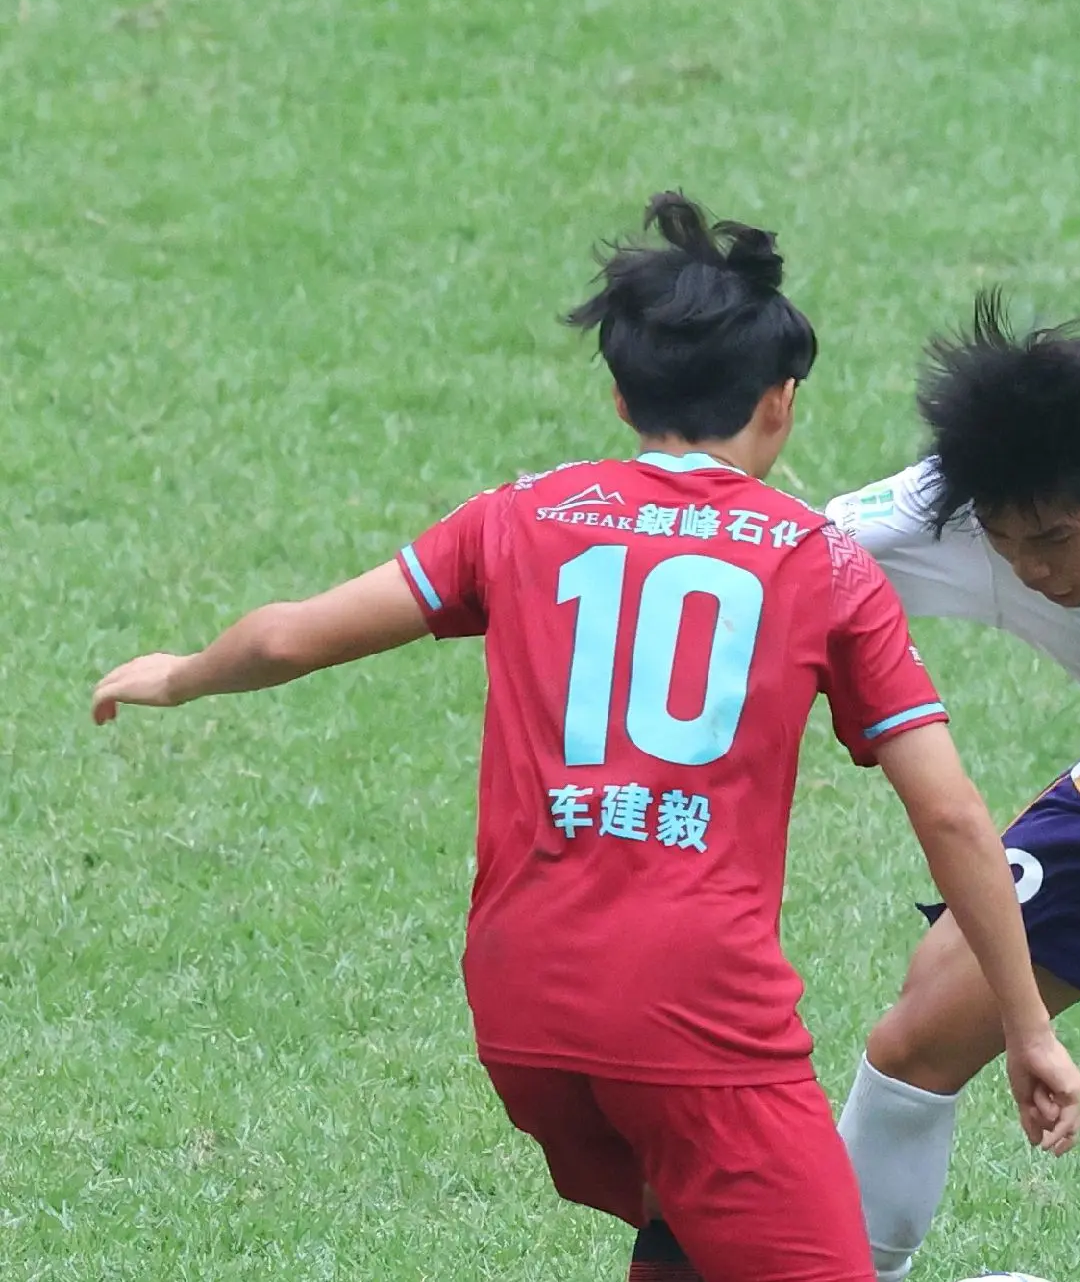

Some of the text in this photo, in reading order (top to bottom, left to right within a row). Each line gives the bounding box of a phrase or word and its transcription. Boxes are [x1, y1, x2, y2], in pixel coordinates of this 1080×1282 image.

[535, 503, 811, 548] SILPEAK 銀峰石化
[556, 545, 764, 766] 10
[548, 782, 711, 853] 车建毅
